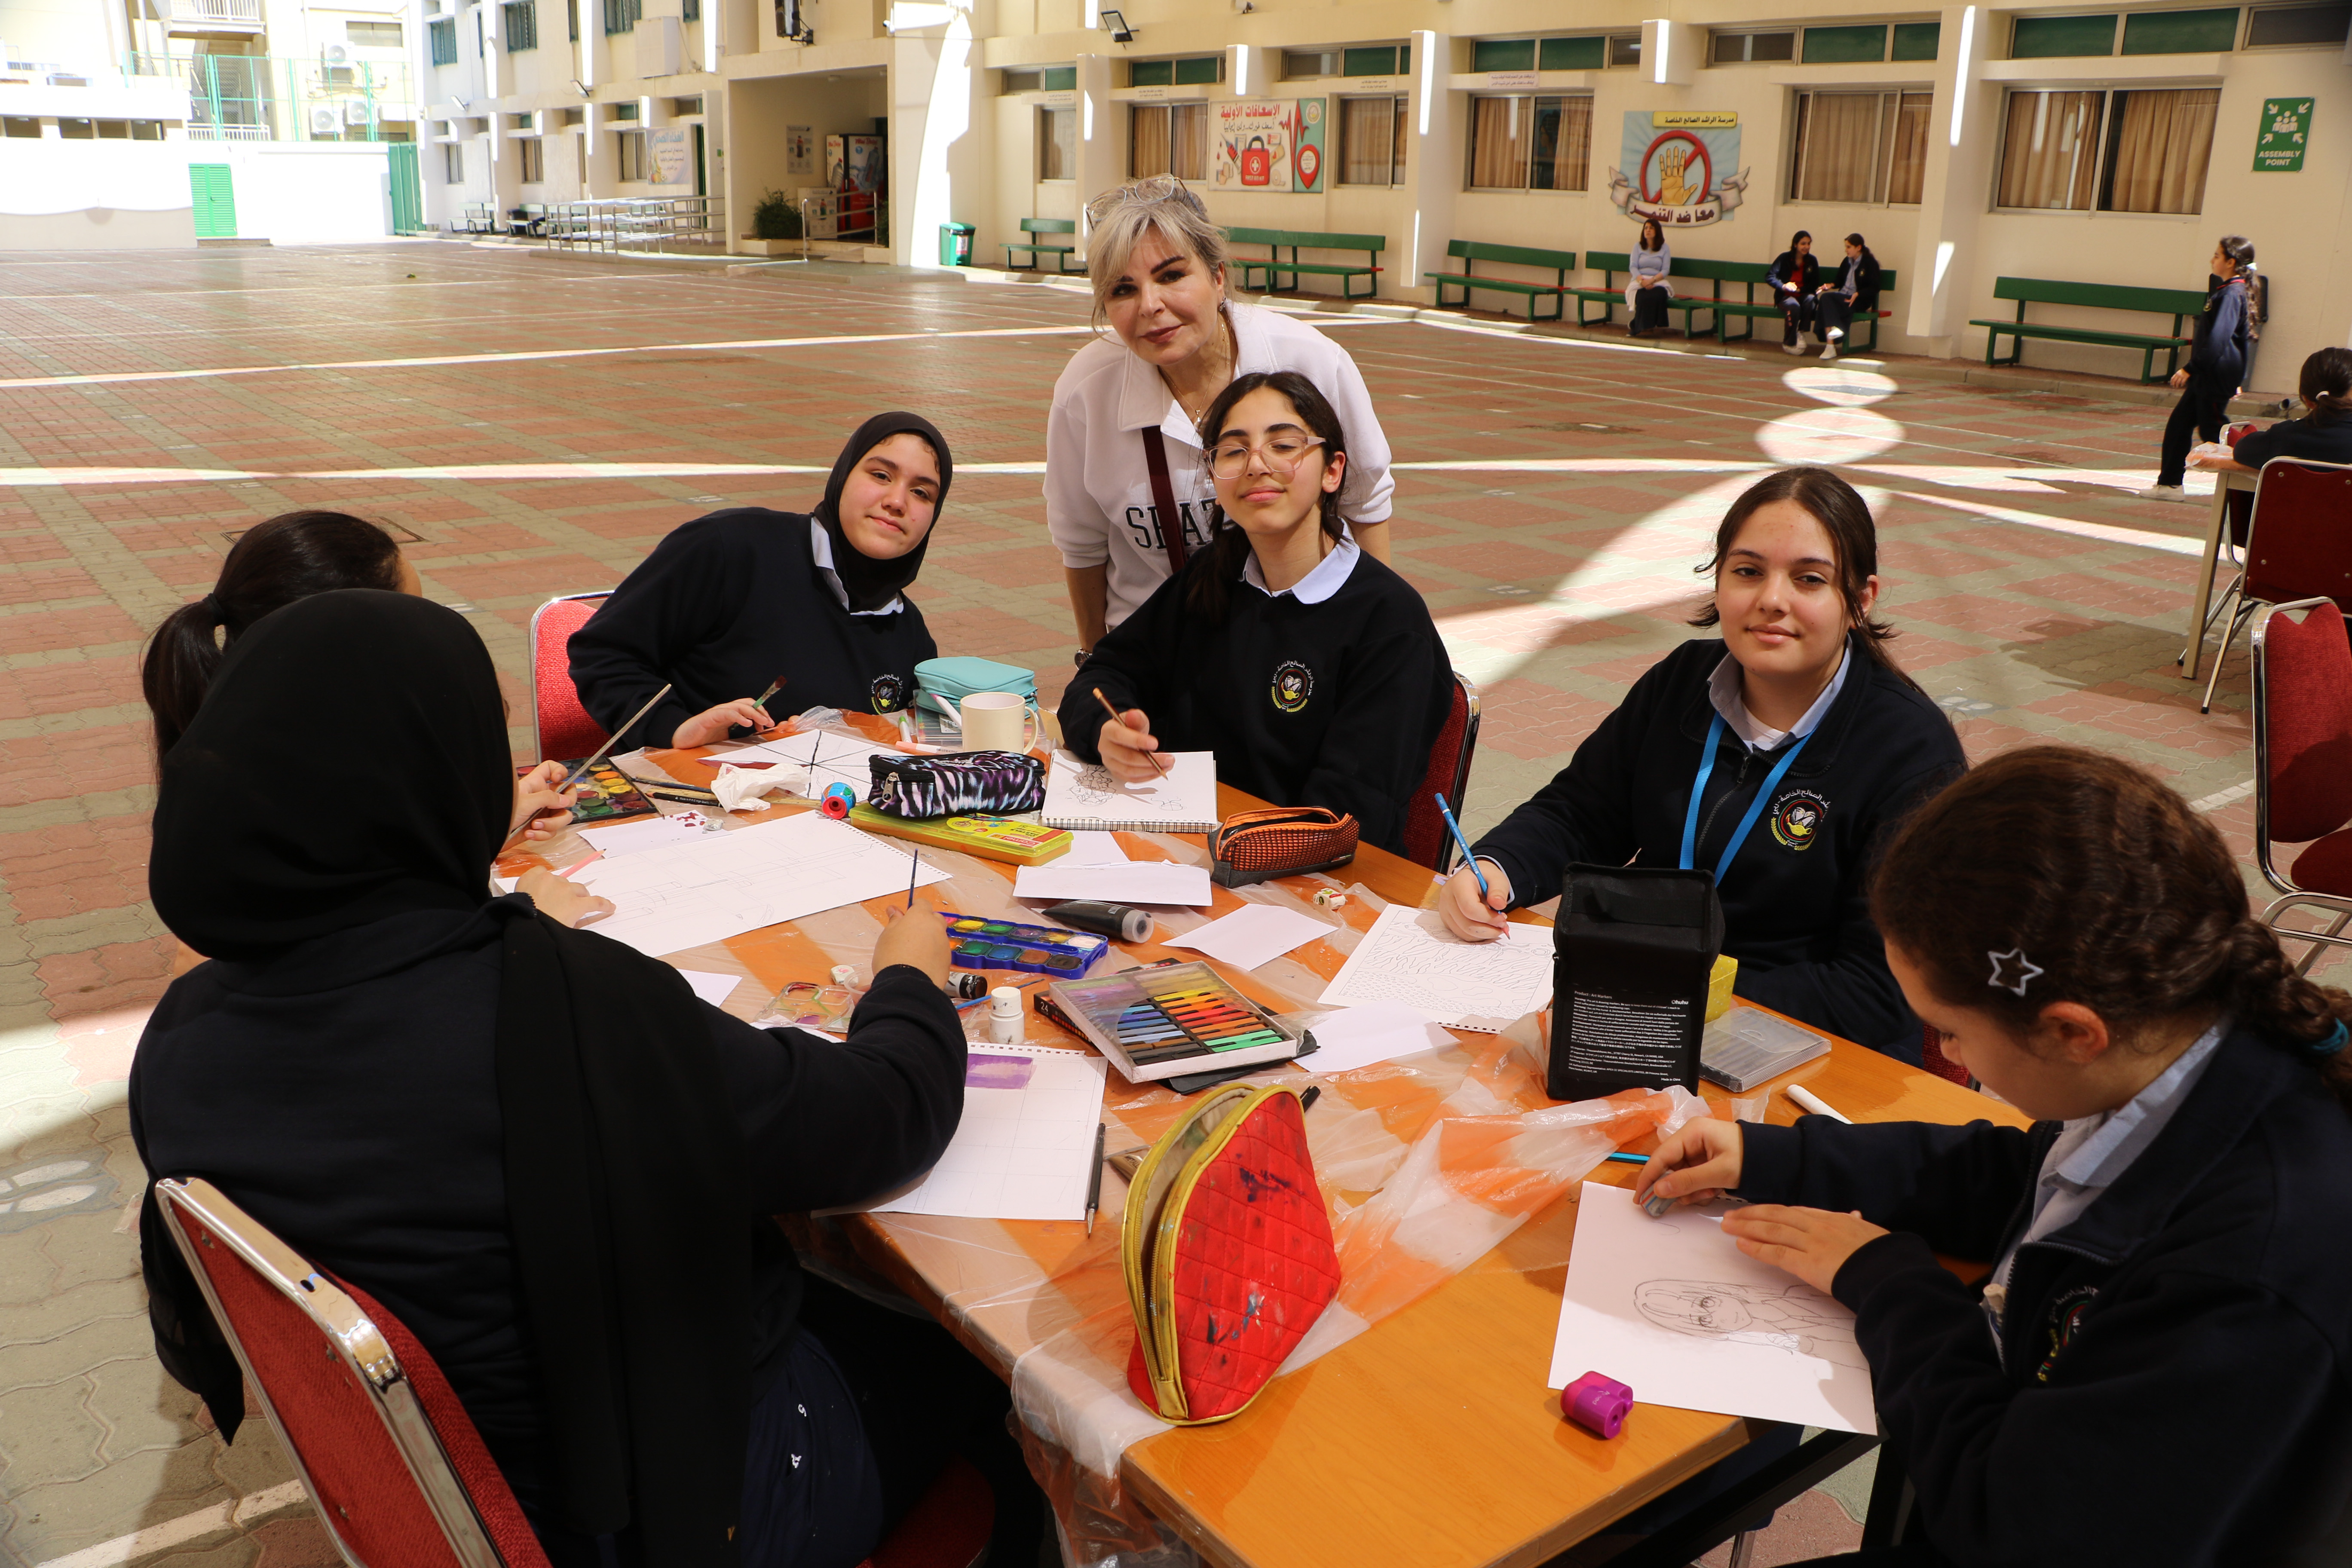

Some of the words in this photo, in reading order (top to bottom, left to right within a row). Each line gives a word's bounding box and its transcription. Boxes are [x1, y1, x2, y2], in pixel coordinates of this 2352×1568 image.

[1221, 103, 1243, 121] الأولية
[1246, 103, 1280, 118] الإسعافات
[1683, 116, 1700, 124] الصالح
[1701, 116, 1717, 124] الراشد
[1718, 116, 1734, 124] مدرسة
[1630, 205, 1674, 223] التنمر
[1676, 211, 1691, 223] ضد
[1695, 208, 1715, 222] معا
[1290, 660, 1305, 669] الصالح
[1779, 789, 1801, 802] الخاصة
[1801, 789, 1822, 801] الصالح
[1003, 836, 1035, 845] Camel
[1040, 1001, 1048, 1012] 24
